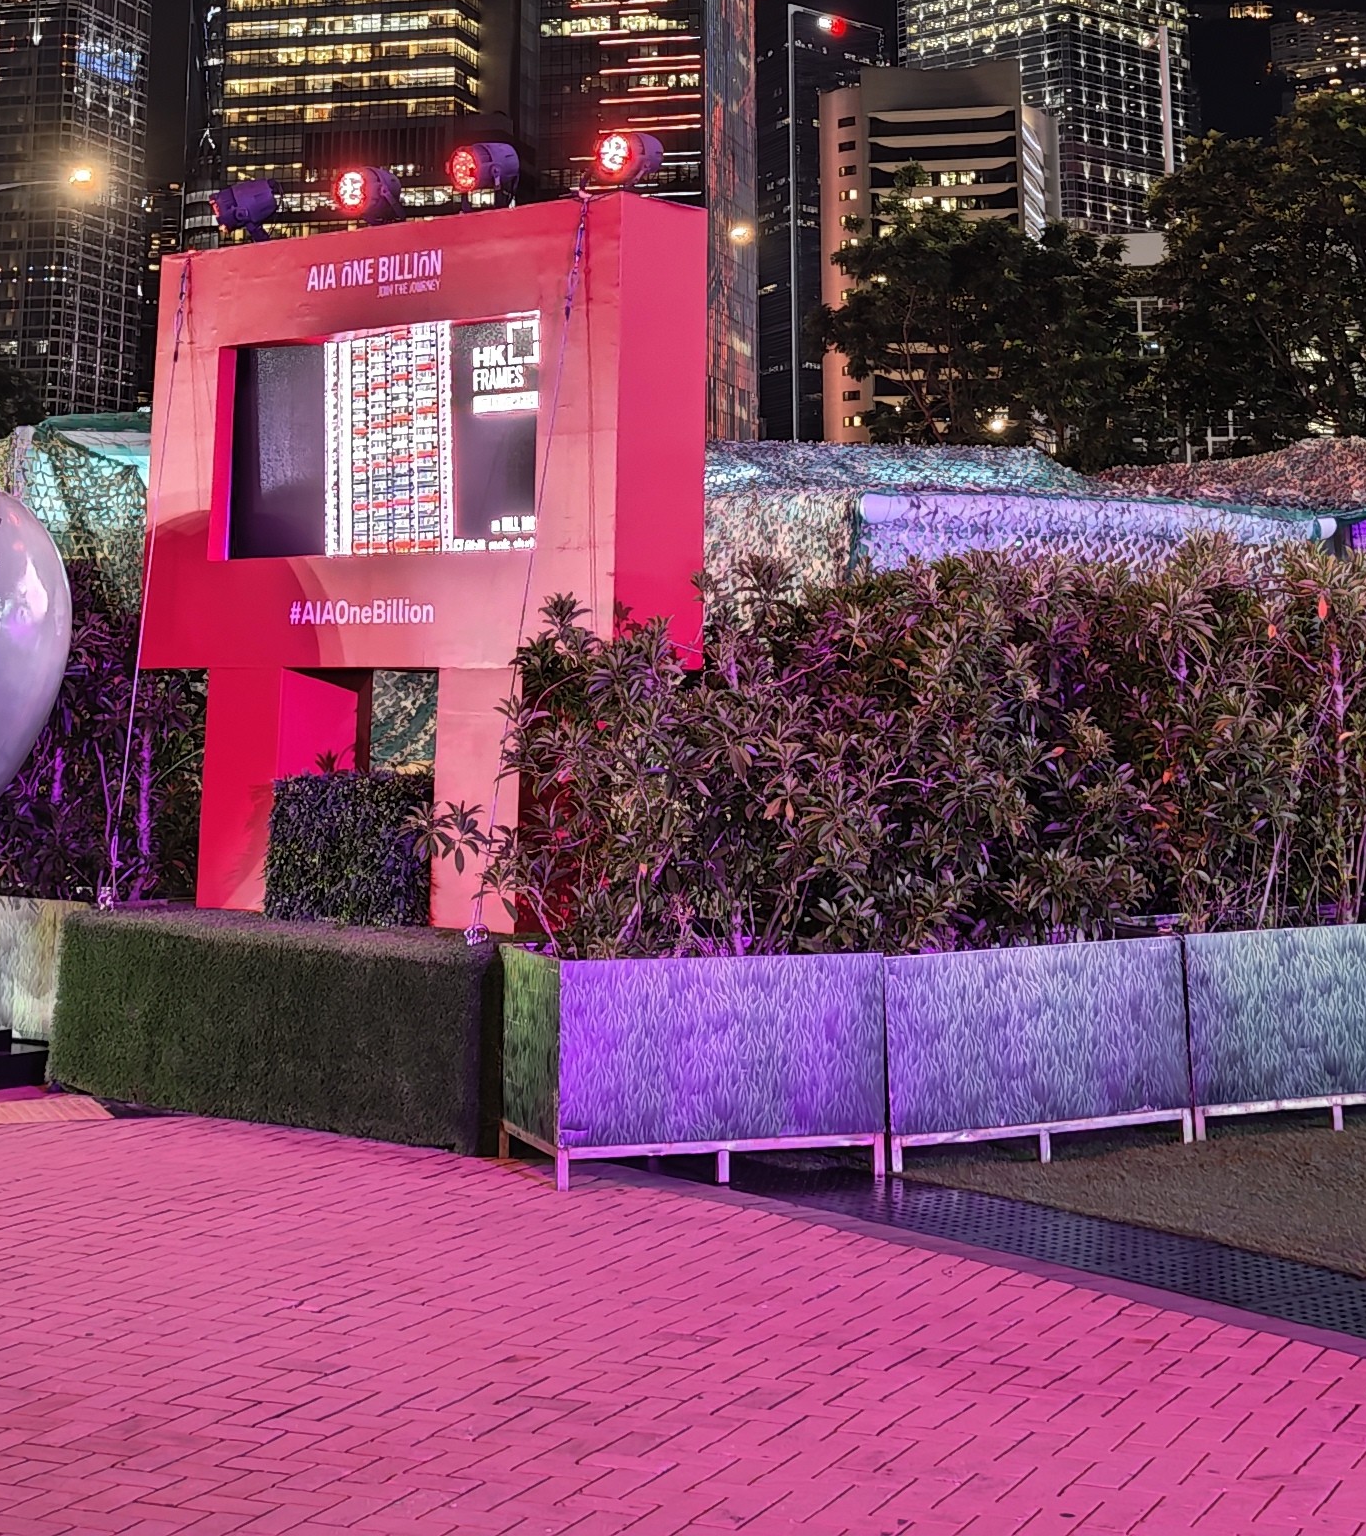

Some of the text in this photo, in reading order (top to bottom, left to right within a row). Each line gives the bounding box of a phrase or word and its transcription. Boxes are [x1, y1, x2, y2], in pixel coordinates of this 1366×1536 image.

[307, 264, 336, 292] AIA
[473, 345, 507, 368] HK
[473, 365, 525, 392] FRAMES
[290, 598, 434, 625] #AIAOneBillion
